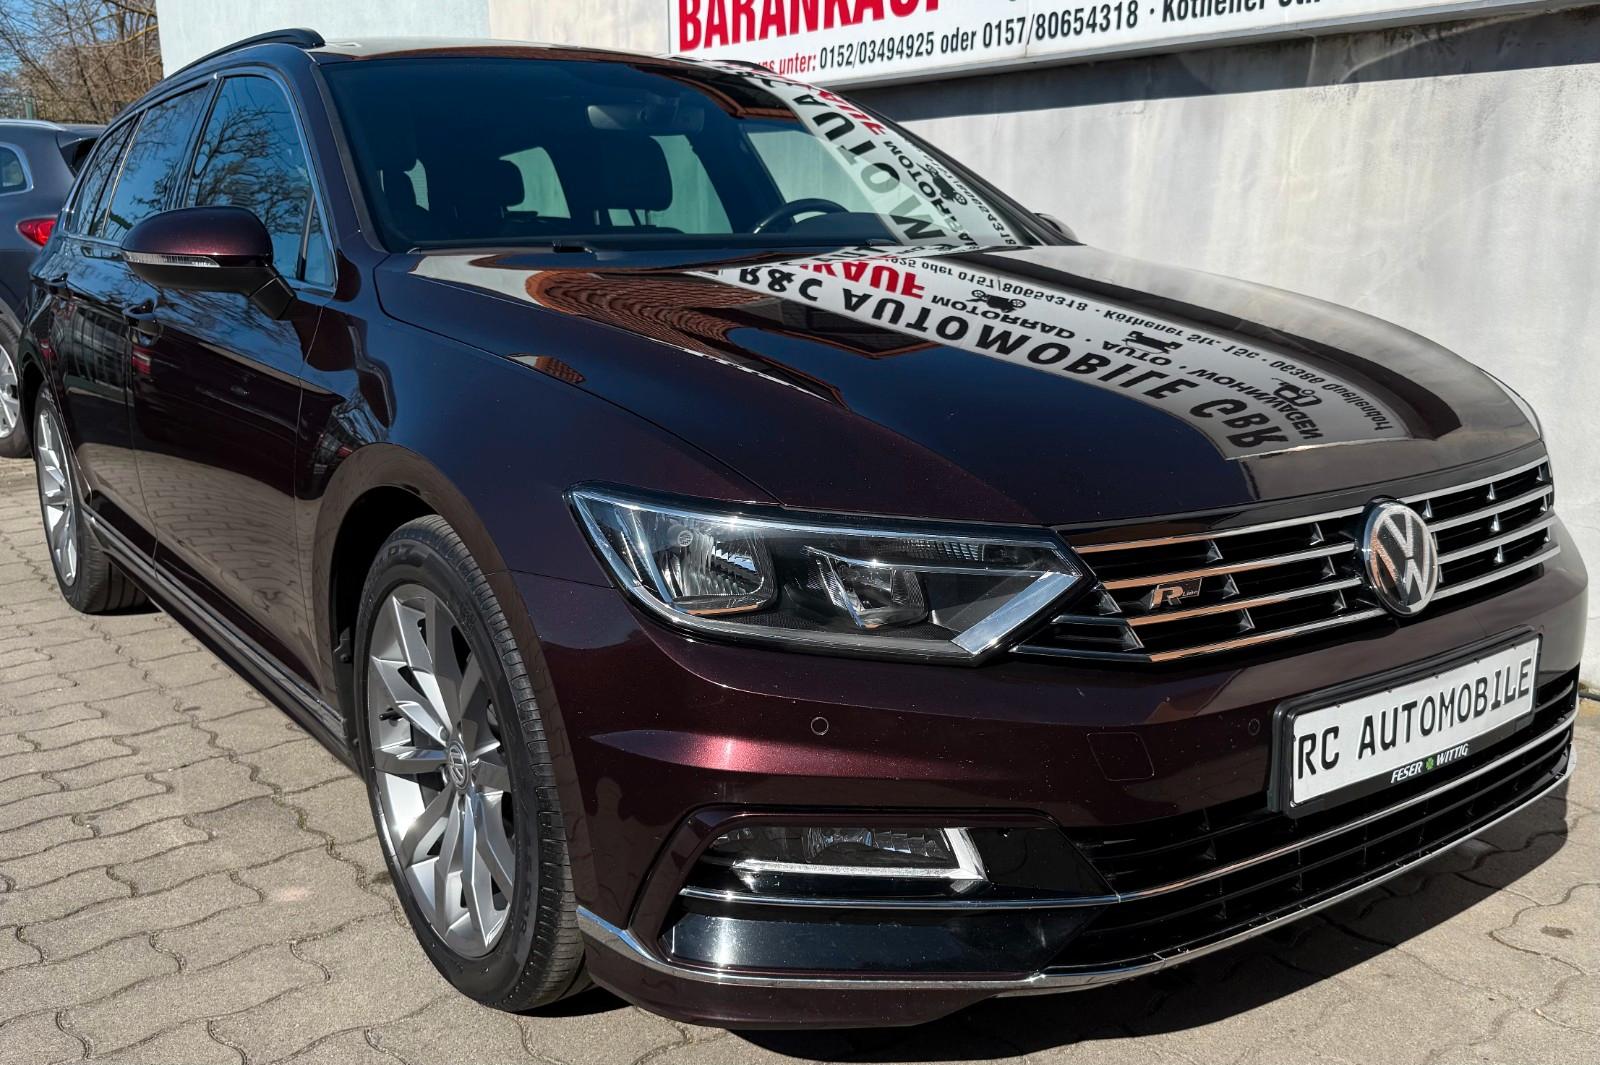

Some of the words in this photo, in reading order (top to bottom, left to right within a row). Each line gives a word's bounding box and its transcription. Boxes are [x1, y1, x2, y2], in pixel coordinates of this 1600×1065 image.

[779, 53, 816, 76] unter:
[820, 31, 934, 68] 0152/03494925
[940, 25, 976, 55] oder
[981, 2, 1139, 50] 0157/80654318
[1297, 726, 1340, 779] RC
[1356, 657, 1532, 761] AUTOMOBILE
[1390, 762, 1425, 784] FESER
[1436, 743, 1469, 767] WITTIG
